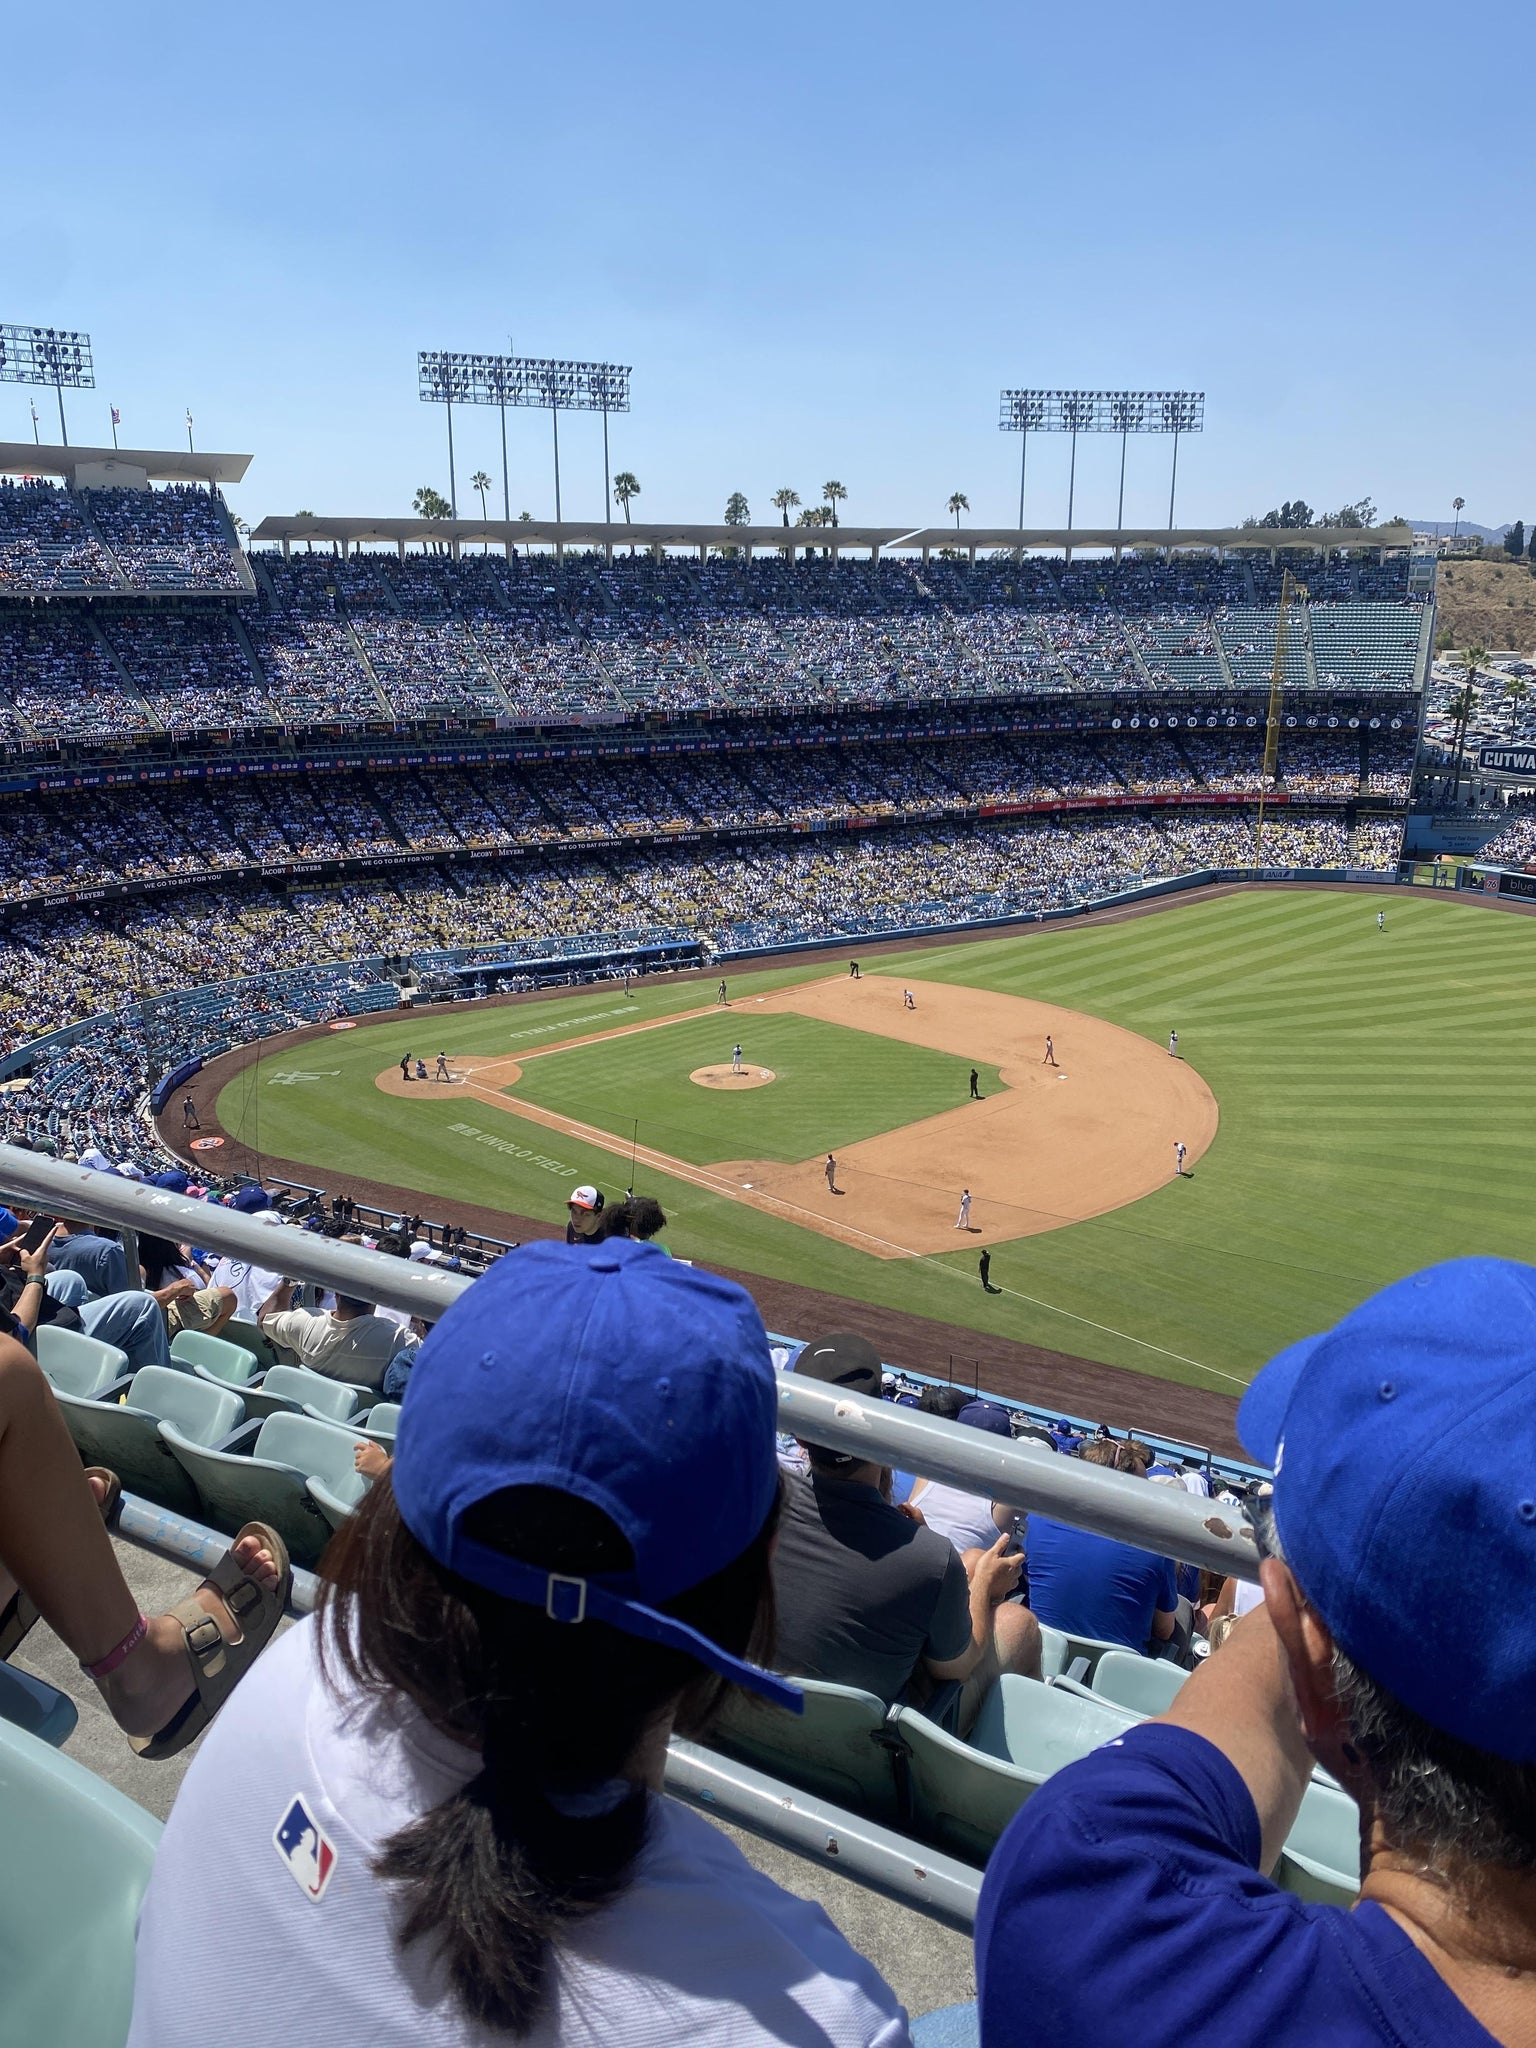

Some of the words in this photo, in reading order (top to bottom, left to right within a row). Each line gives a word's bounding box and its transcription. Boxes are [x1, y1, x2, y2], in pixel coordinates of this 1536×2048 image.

[1484, 751, 1536, 769] CUTWA
[653, 836, 673, 844] JACOBY
[677, 833, 701, 841] MEYERS
[470, 850, 493, 858] JACOBY
[498, 848, 524, 856] MEYERS
[261, 867, 286, 876] JACOBY
[292, 864, 322, 873] MEYERS
[178, 877, 191, 885] BAT
[1486, 880, 1498, 889] 76
[1510, 879, 1534, 892] blue
[43, 896, 70, 907] JACOBY
[75, 890, 105, 901] MEYERS
[475, 1133, 533, 1158] UNIQLO
[526, 1155, 578, 1177] FIELD
